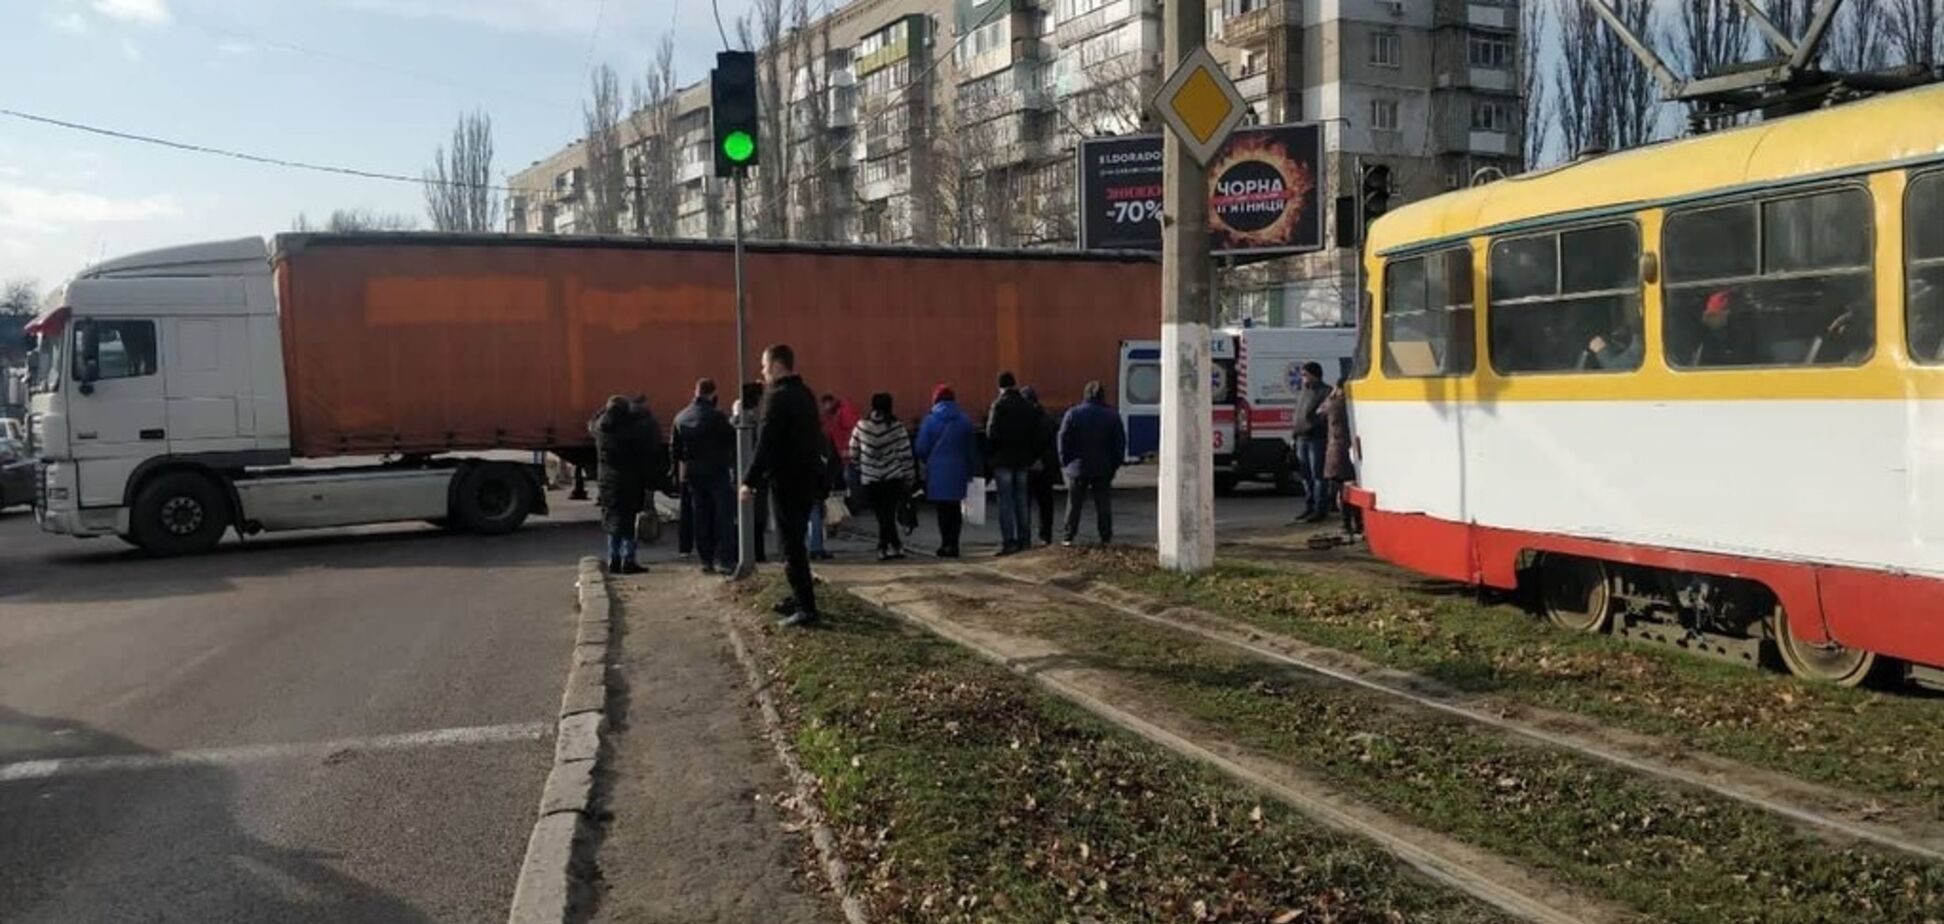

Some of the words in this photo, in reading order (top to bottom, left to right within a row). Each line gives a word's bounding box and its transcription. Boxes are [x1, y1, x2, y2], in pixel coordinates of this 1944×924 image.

[1099, 152, 1160, 164] ELDORADO
[1217, 178, 1283, 196] ЧОРНА
[1105, 200, 1163, 223] -70%
[1217, 198, 1284, 213] ПЯТНИЦЯ
